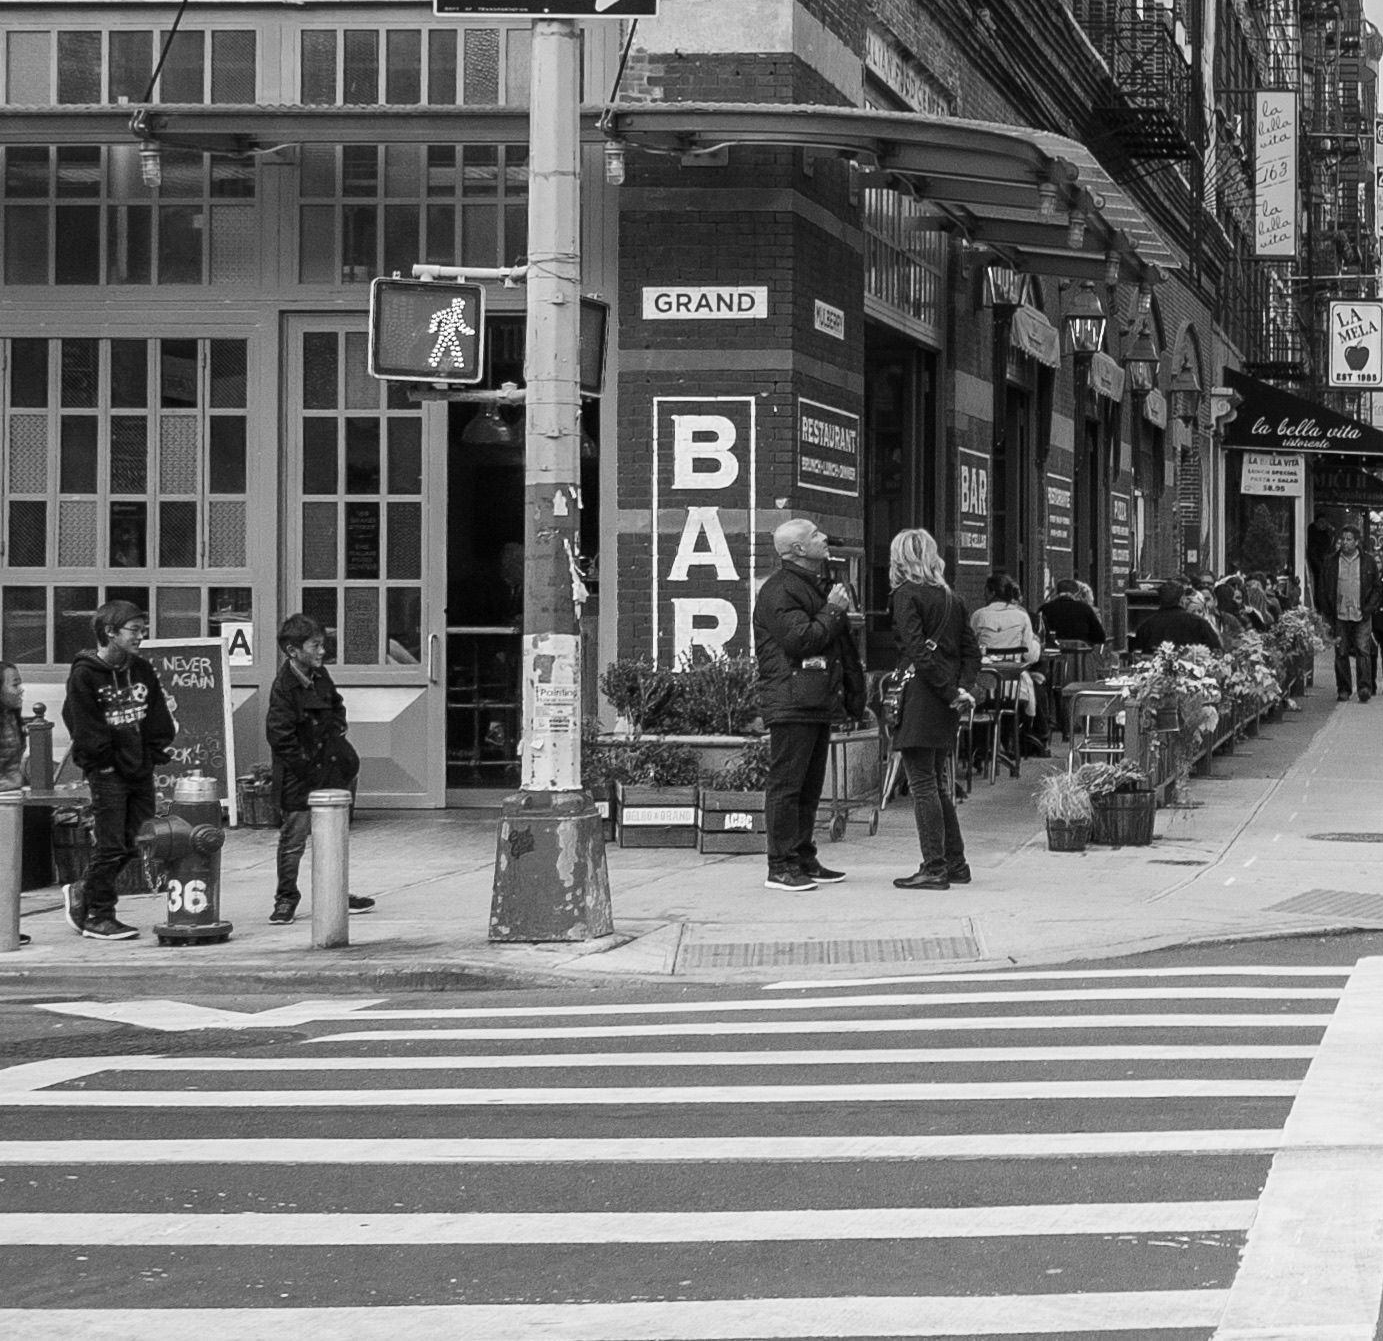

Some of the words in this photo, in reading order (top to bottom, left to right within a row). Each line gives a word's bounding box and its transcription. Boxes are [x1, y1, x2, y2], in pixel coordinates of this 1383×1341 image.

[654, 293, 756, 313] GRAND
[1336, 307, 1363, 327] LA
[1337, 320, 1378, 344] MELA
[1336, 372, 1353, 382] EST
[802, 416, 856, 454] RESTAURANT
[1252, 416, 1272, 435] la
[1277, 417, 1322, 438] bella
[1326, 425, 1362, 440] vita
[1282, 438, 1331, 450] ristorante
[961, 465, 987, 515] BAR
[666, 415, 741, 673] BAR
[228, 628, 252, 656] A
[163, 656, 212, 673] NEVER
[171, 673, 215, 689] AGAIN
[540, 688, 577, 699] Painting
[167, 879, 208, 914] 36
